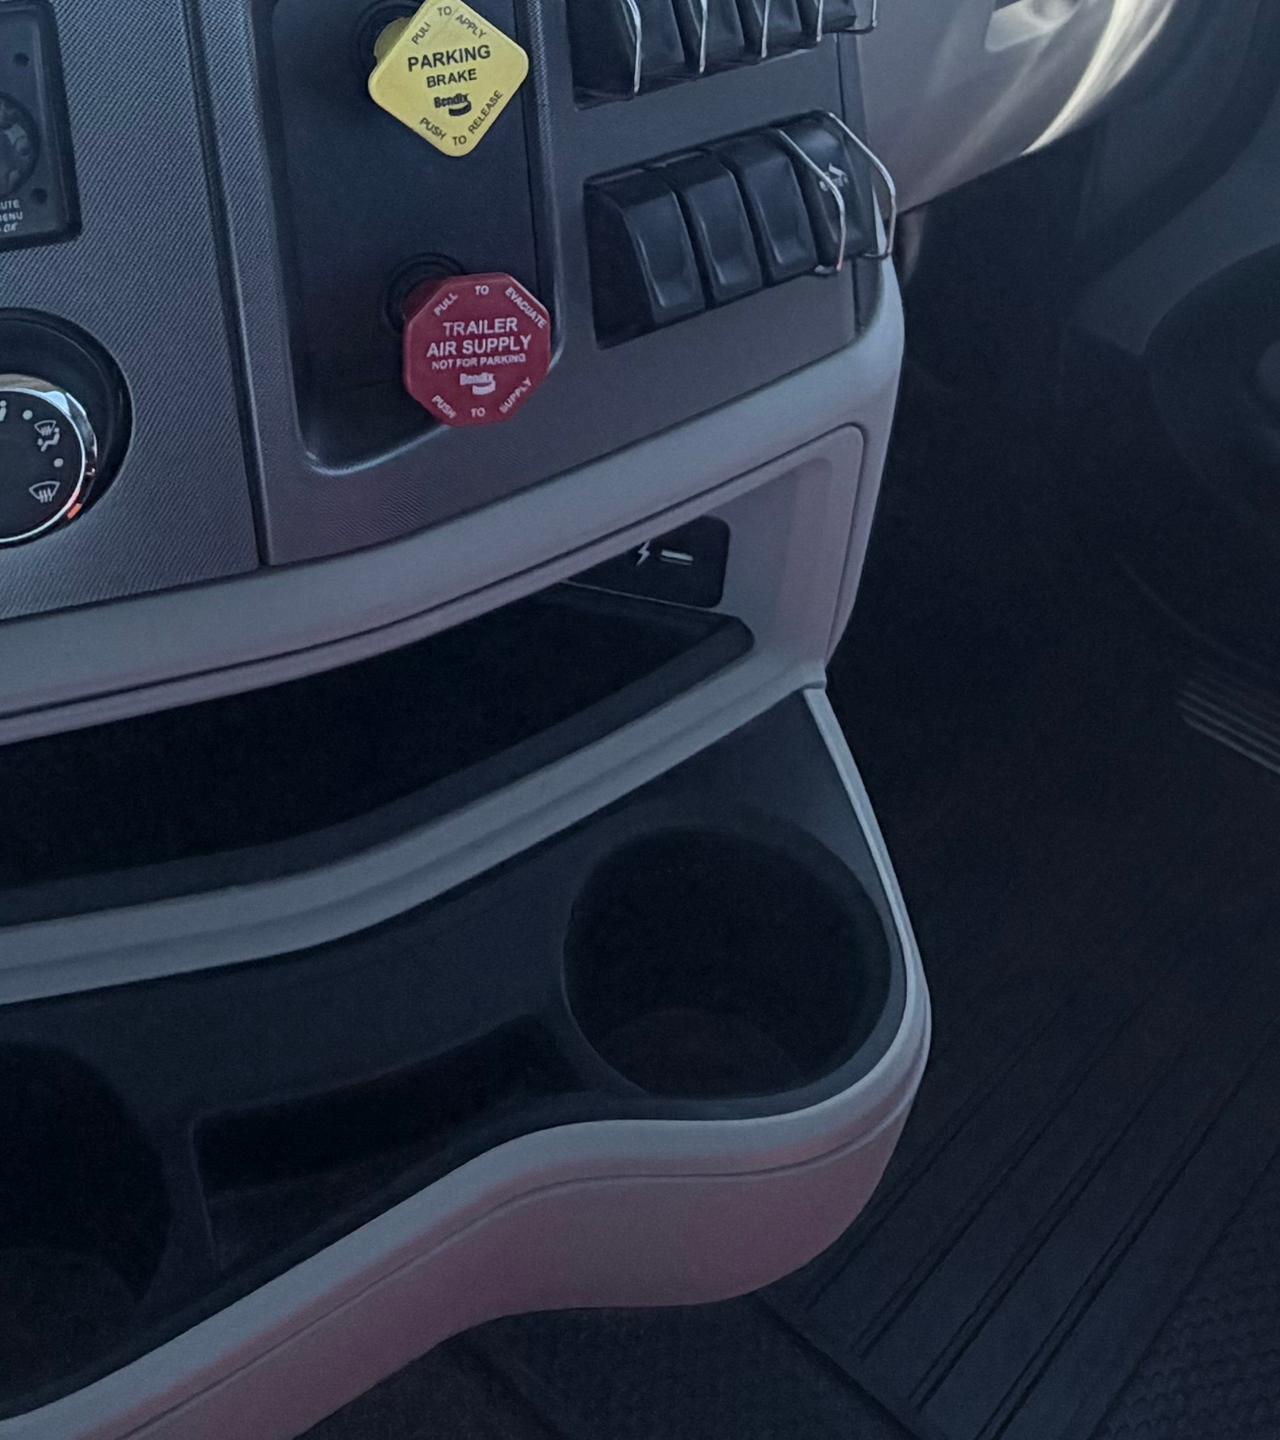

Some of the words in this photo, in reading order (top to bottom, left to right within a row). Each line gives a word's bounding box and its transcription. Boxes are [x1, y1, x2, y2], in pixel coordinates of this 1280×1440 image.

[438, 6, 452, 16] TO
[455, 13, 487, 40] APPLY
[407, 44, 492, 72] PARKING
[426, 68, 478, 89] BRAKE
[434, 92, 470, 109] Bendix
[420, 116, 447, 141] PUSH
[453, 135, 466, 146] TO
[468, 90, 503, 134] RELEASE
[433, 292, 458, 317] PULL
[474, 285, 489, 296] TO
[505, 286, 548, 329] EVACUATE
[443, 317, 518, 338] TRAILER
[426, 341, 457, 358] AIR
[462, 334, 532, 355] SUPPLY
[432, 358, 455, 371] NOT
[456, 356, 478, 368] FOR
[479, 353, 527, 366] PARKING
[432, 394, 457, 419] PUSH
[471, 408, 485, 417] TO
[499, 376, 533, 414] SUPPLY
